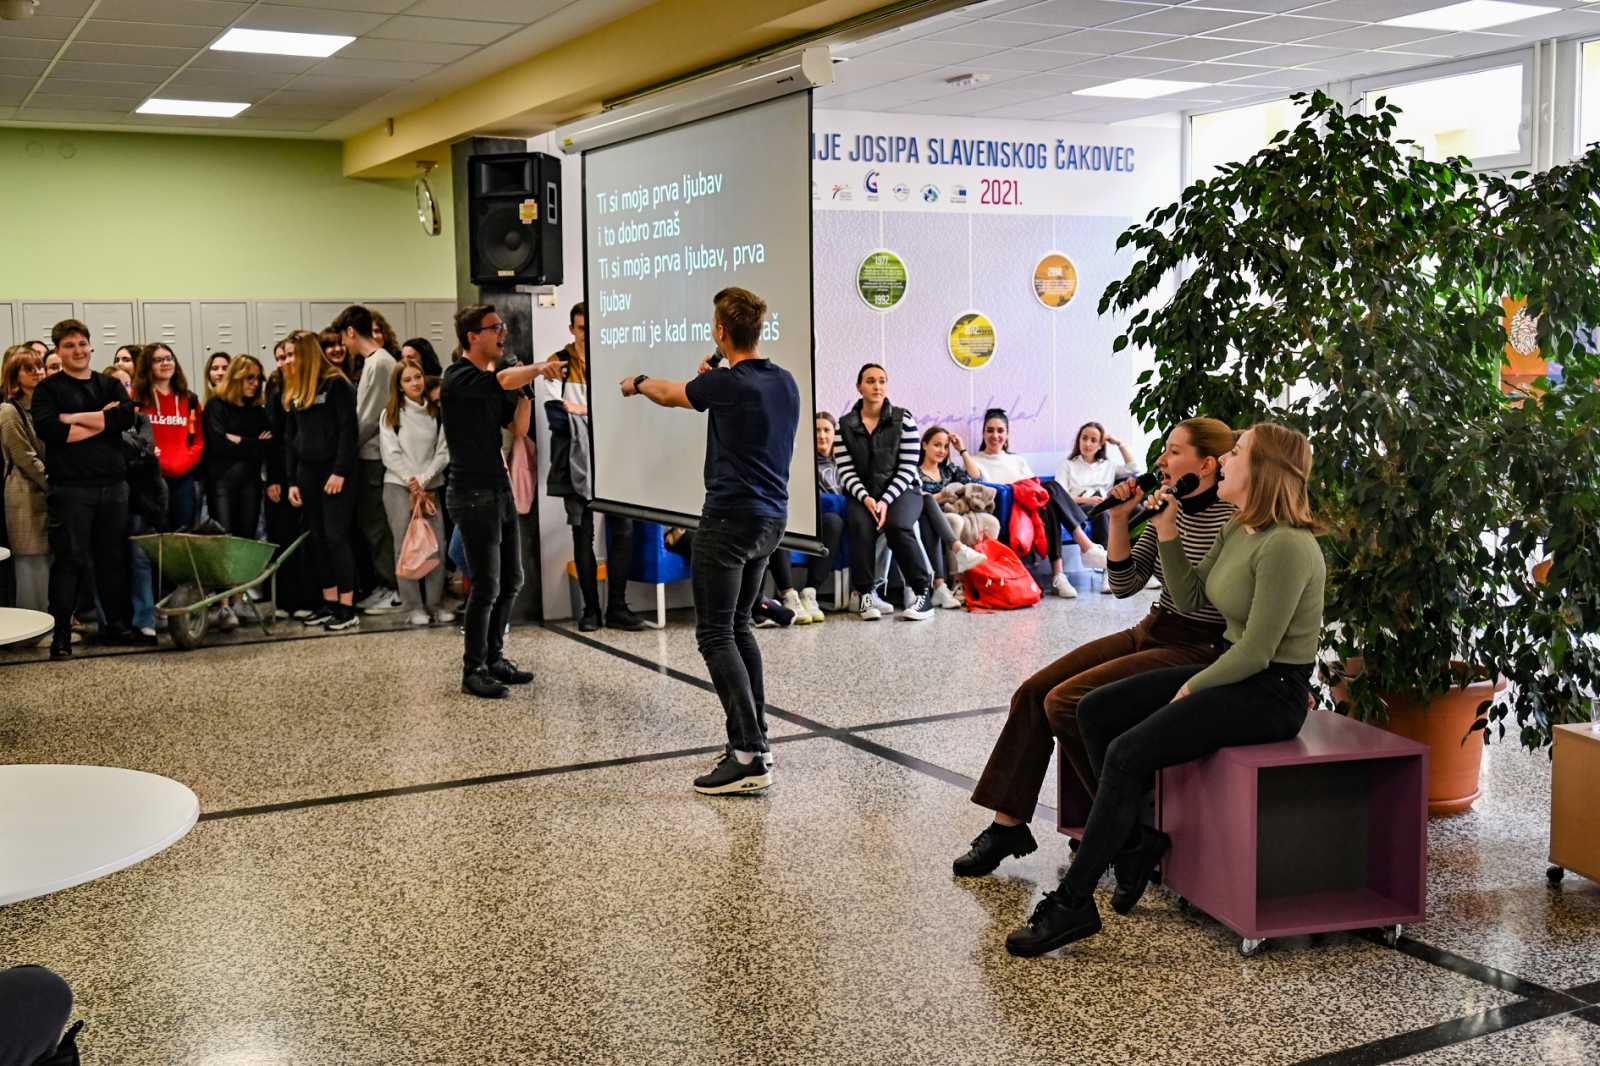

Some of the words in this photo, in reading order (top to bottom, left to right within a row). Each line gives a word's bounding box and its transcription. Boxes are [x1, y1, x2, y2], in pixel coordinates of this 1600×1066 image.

[849, 133, 920, 163] JOSIPA
[927, 138, 1047, 169] SLAVENSKOG
[1055, 138, 1135, 172] ČAKOVEC
[597, 193, 607, 214] Ti
[609, 189, 618, 213] si
[621, 184, 649, 212] moja
[652, 180, 679, 210] prva
[682, 171, 723, 204] ljubav
[980, 179, 1023, 205] 2021.
[604, 228, 615, 246] to
[618, 220, 649, 243] dobro
[652, 210, 680, 239] znaš
[598, 258, 608, 280] Ti
[611, 256, 620, 277] si
[623, 253, 650, 280] moja
[654, 251, 680, 279] prva
[684, 243, 728, 276] ljubav,
[733, 242, 765, 271] prva
[599, 290, 631, 318] ljubav
[600, 322, 629, 349] super
[632, 320, 645, 344] mi
[649, 319, 661, 348] je
[665, 317, 687, 343] kad
[691, 321, 712, 342] me
